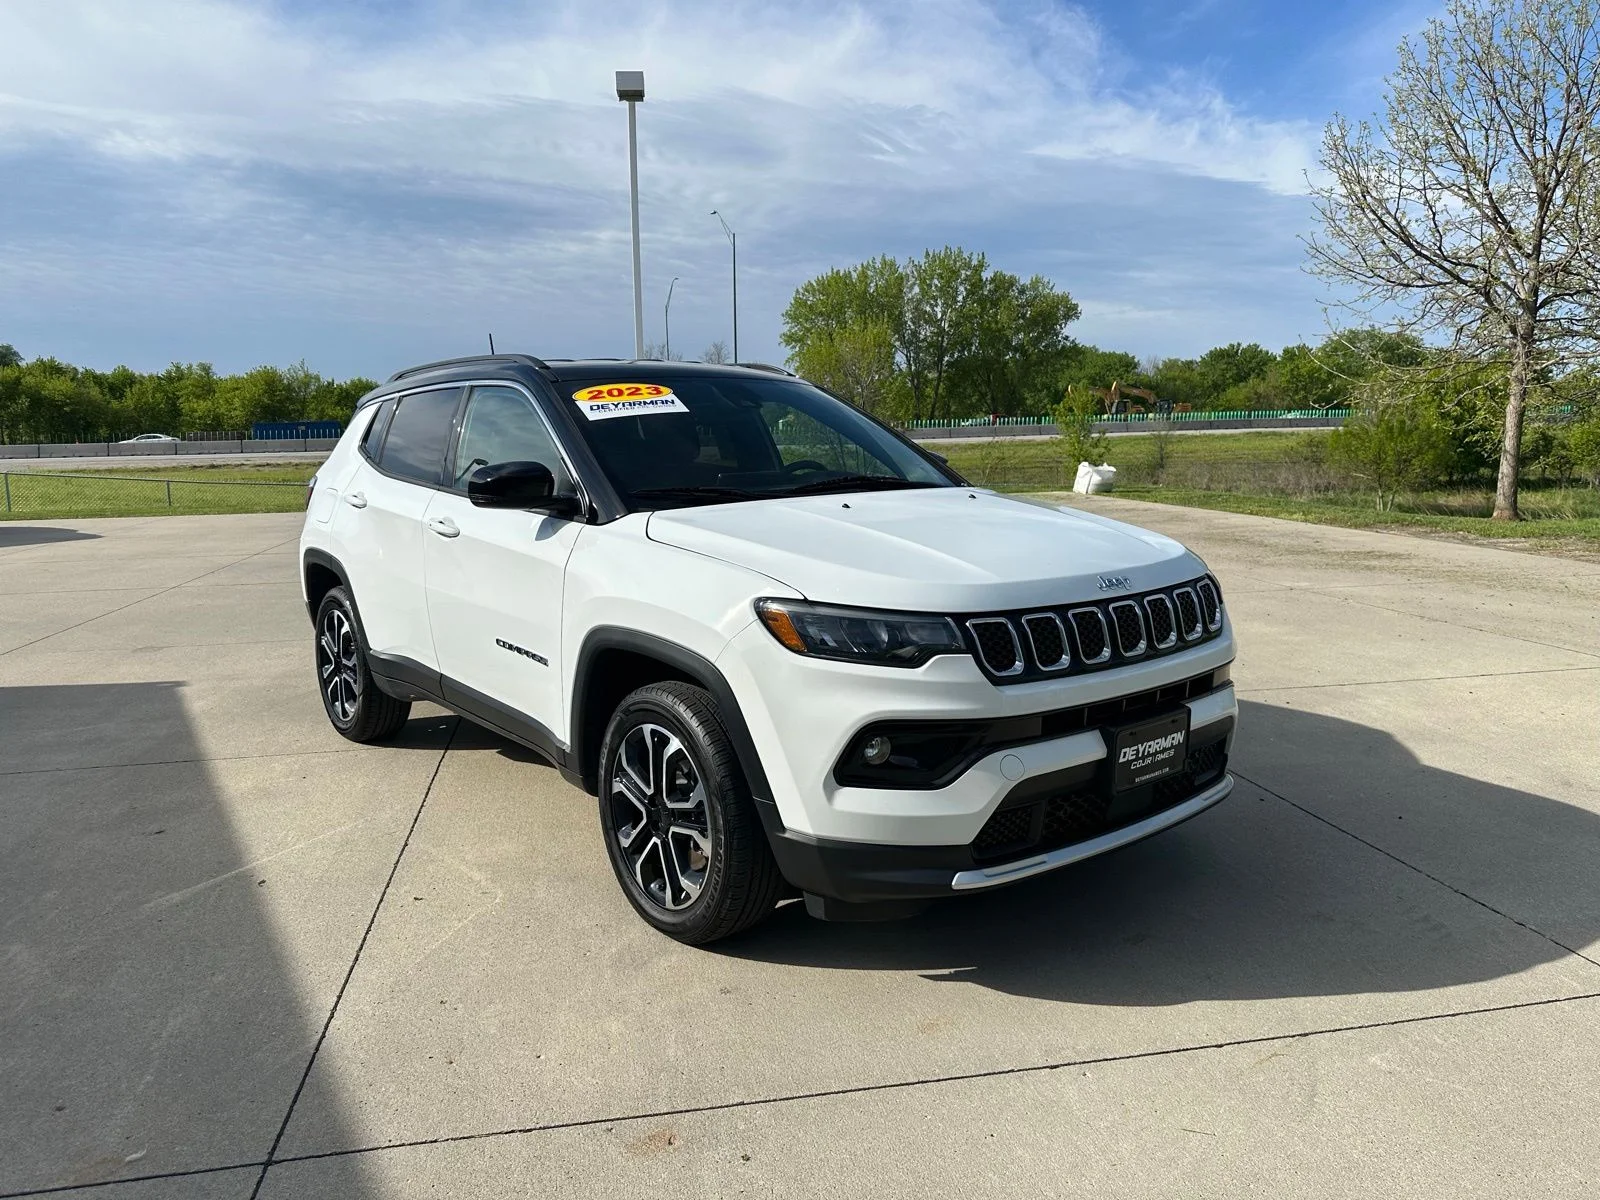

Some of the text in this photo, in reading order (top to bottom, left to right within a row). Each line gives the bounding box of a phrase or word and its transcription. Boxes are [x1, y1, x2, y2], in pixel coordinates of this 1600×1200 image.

[587, 386, 662, 400] 2023
[589, 399, 675, 411] DEYARMAN
[1096, 575, 1131, 592] Jeep
[495, 638, 549, 667] COMPASS
[1118, 730, 1186, 763] DEYARMAN
[1154, 749, 1175, 762] AMES
